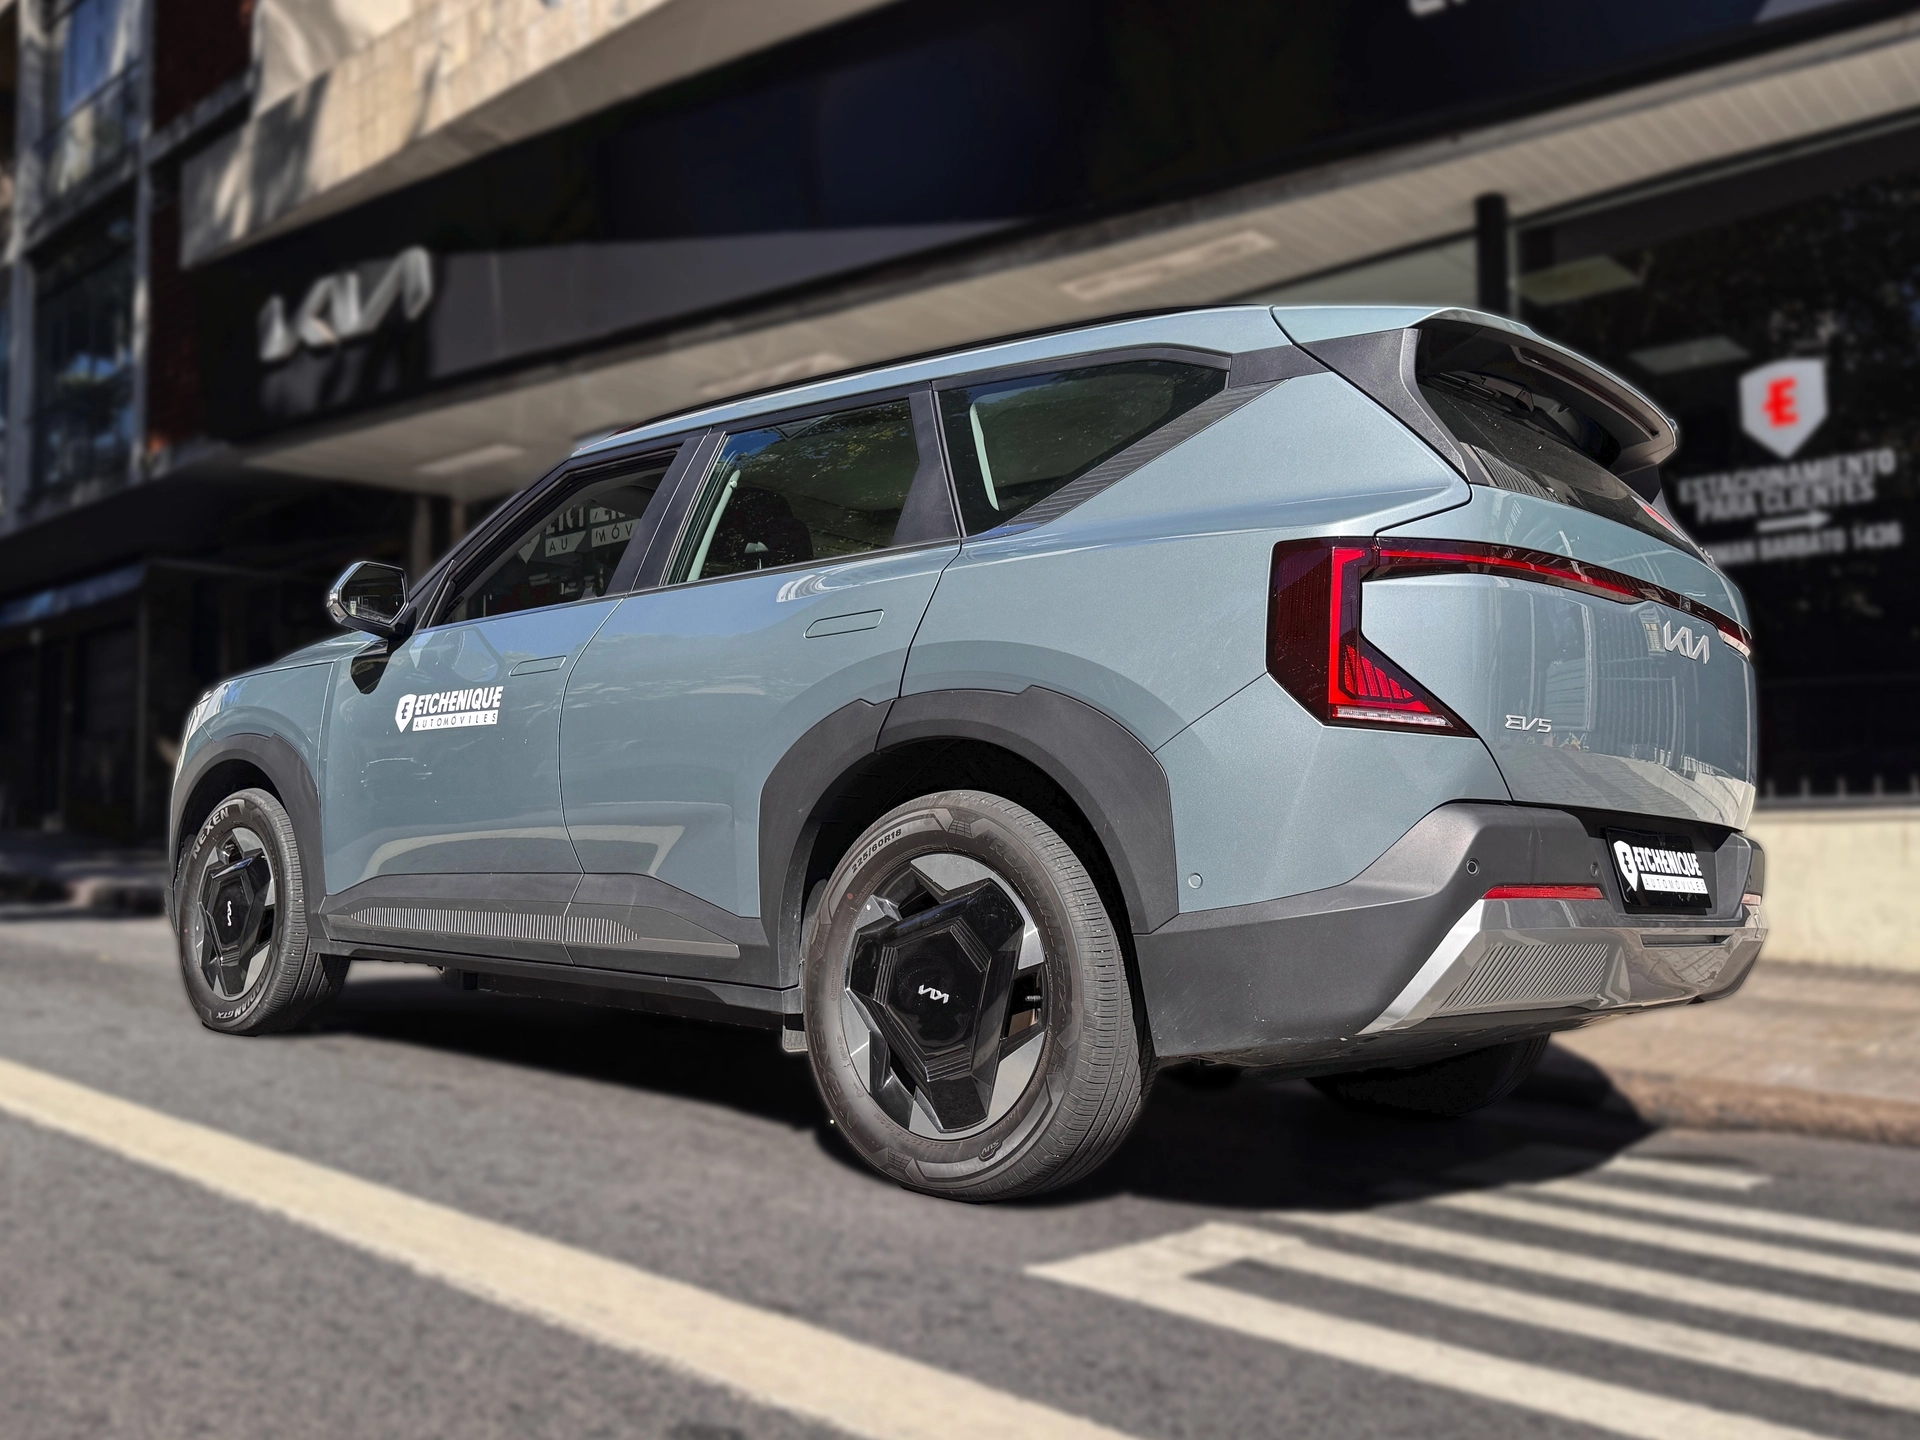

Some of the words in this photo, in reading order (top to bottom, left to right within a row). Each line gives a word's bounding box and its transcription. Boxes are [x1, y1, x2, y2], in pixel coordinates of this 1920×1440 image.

[1678, 447, 1896, 504] ESTACIONAMIENTO
[1696, 489, 1757, 525] PARA
[1763, 475, 1876, 515] CLIENTES
[1663, 620, 1710, 664] KIA
[414, 686, 504, 715] ETCHENIQUE
[1505, 714, 1552, 733] EV5
[192, 807, 230, 859] NEXEN
[851, 828, 902, 873] 225/60R18
[1632, 846, 1702, 876] ETCHENIQUE
